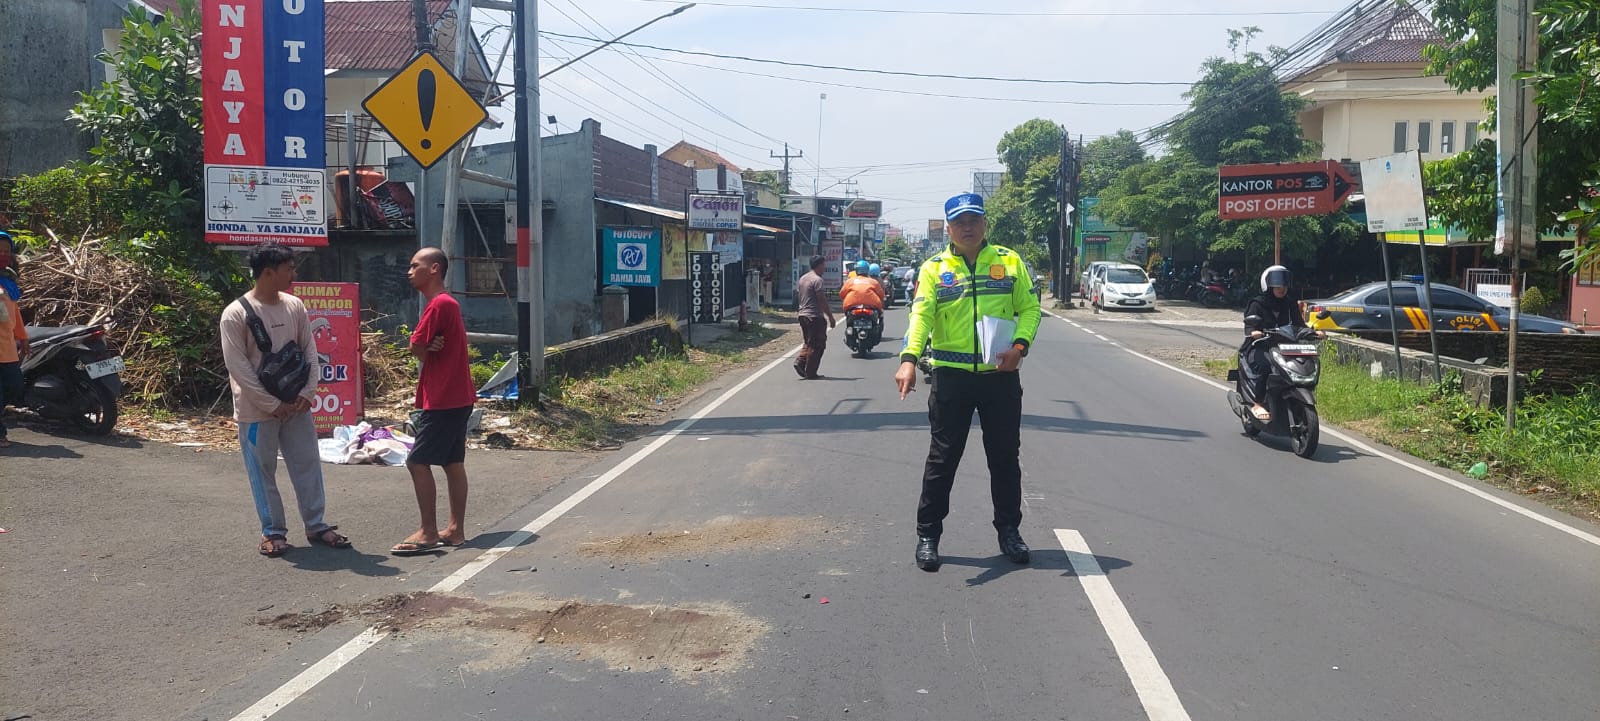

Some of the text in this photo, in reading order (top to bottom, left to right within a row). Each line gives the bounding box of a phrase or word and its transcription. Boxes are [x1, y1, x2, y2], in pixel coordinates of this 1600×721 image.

[282, 172, 310, 180] Hubungi
[1222, 177, 1303, 193] KANTOR POS
[692, 197, 739, 211] Canon
[1225, 195, 1316, 213] POST OFFICE
[256, 225, 272, 233] YA
[274, 226, 325, 235] SANJAYA
[613, 230, 653, 240] FOTOCOPY
[634, 274, 652, 284] JAYA
[293, 286, 341, 296] SIOMAY
[692, 254, 702, 323] FOTOCOPY
[711, 254, 721, 322] FOTOCOPY
[304, 299, 353, 309] ATAGOR
[1449, 313, 1485, 328] POLISI
